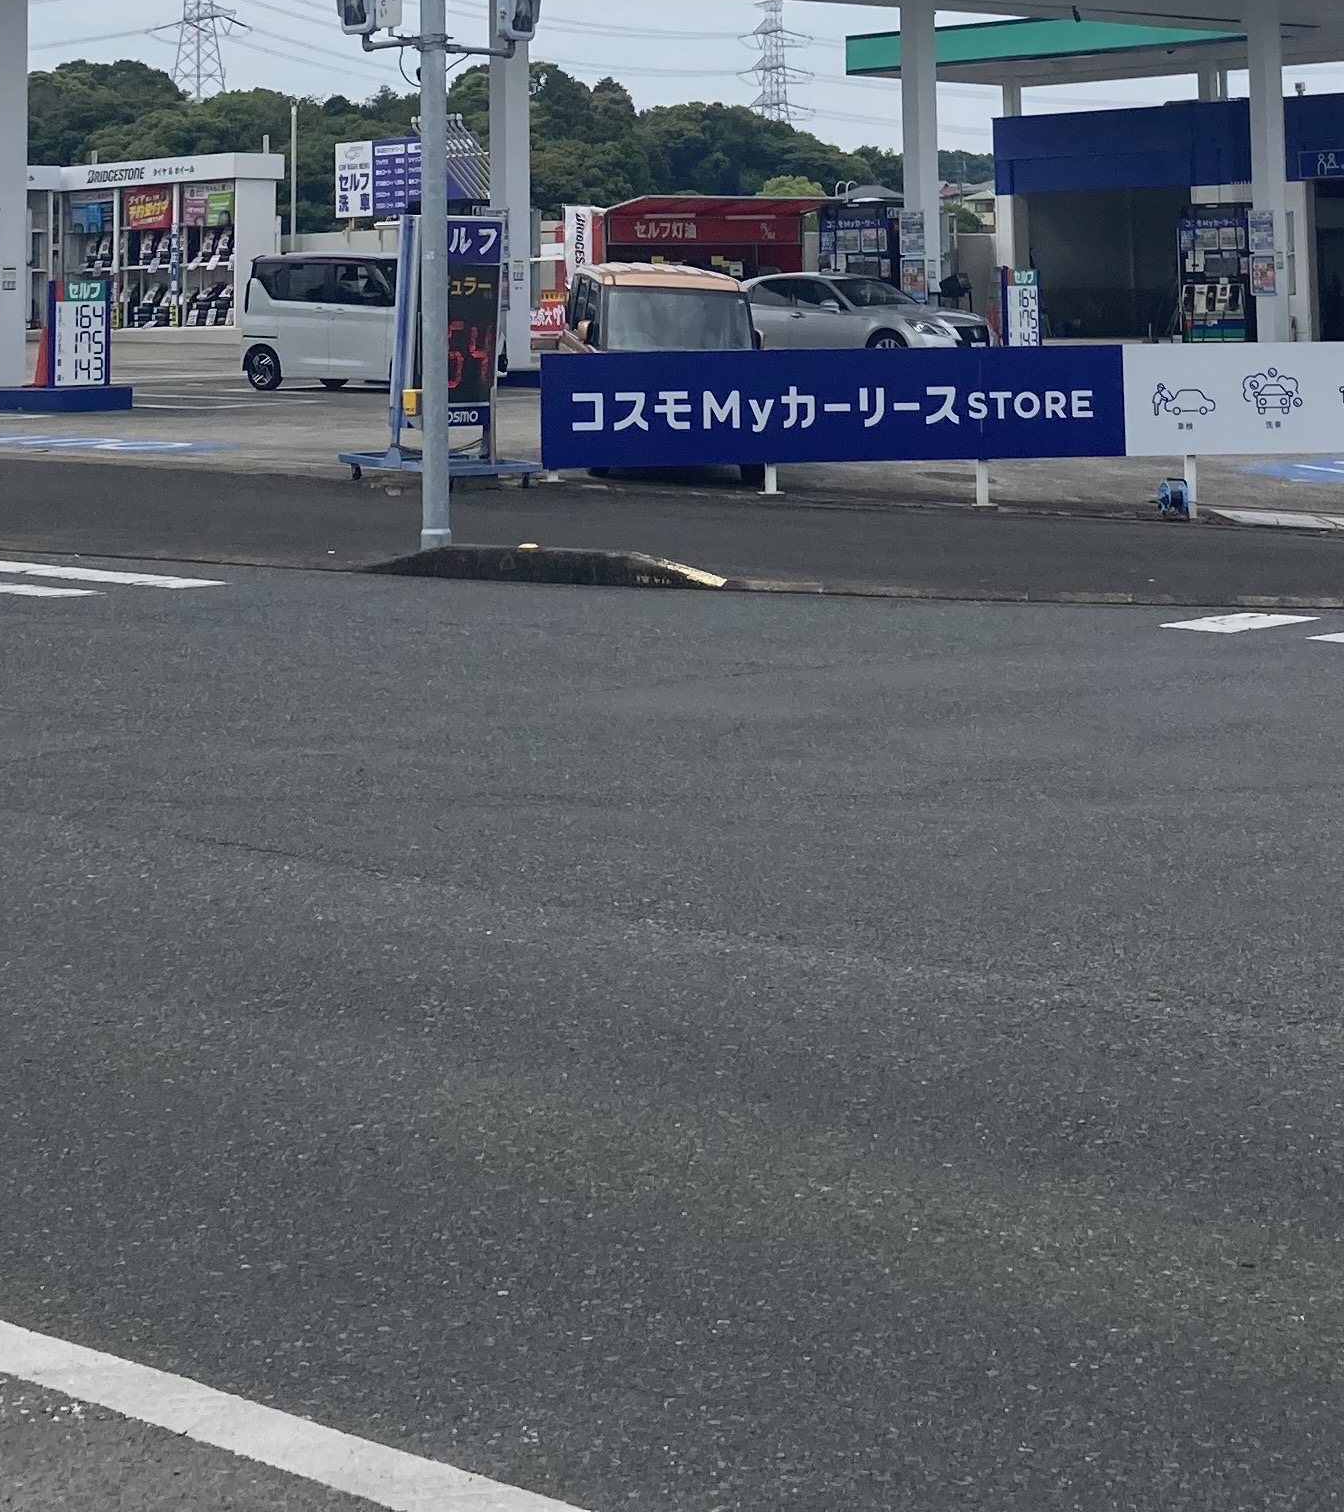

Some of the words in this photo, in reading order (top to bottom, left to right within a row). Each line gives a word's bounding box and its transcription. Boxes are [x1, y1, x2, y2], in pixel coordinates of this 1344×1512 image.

[87, 166, 146, 184] BRIDGESTONE
[339, 173, 370, 192] セルフ
[634, 222, 697, 239] セルフ灯油
[448, 227, 498, 255] ルフ
[575, 213, 586, 268] BRIDGES
[448, 277, 491, 296] ュラー
[1014, 271, 1034, 284] セルフ
[68, 282, 101, 299] セルフ
[1019, 288, 1037, 307] 164
[75, 305, 104, 328] 164
[1019, 309, 1038, 329] 175
[75, 331, 104, 354] 175
[75, 357, 104, 381] 143
[448, 410, 479, 423] OSMO
[571, 385, 1094, 433] コスモMyカーリースSTORE
[1265, 420, 1282, 429] 洗車
